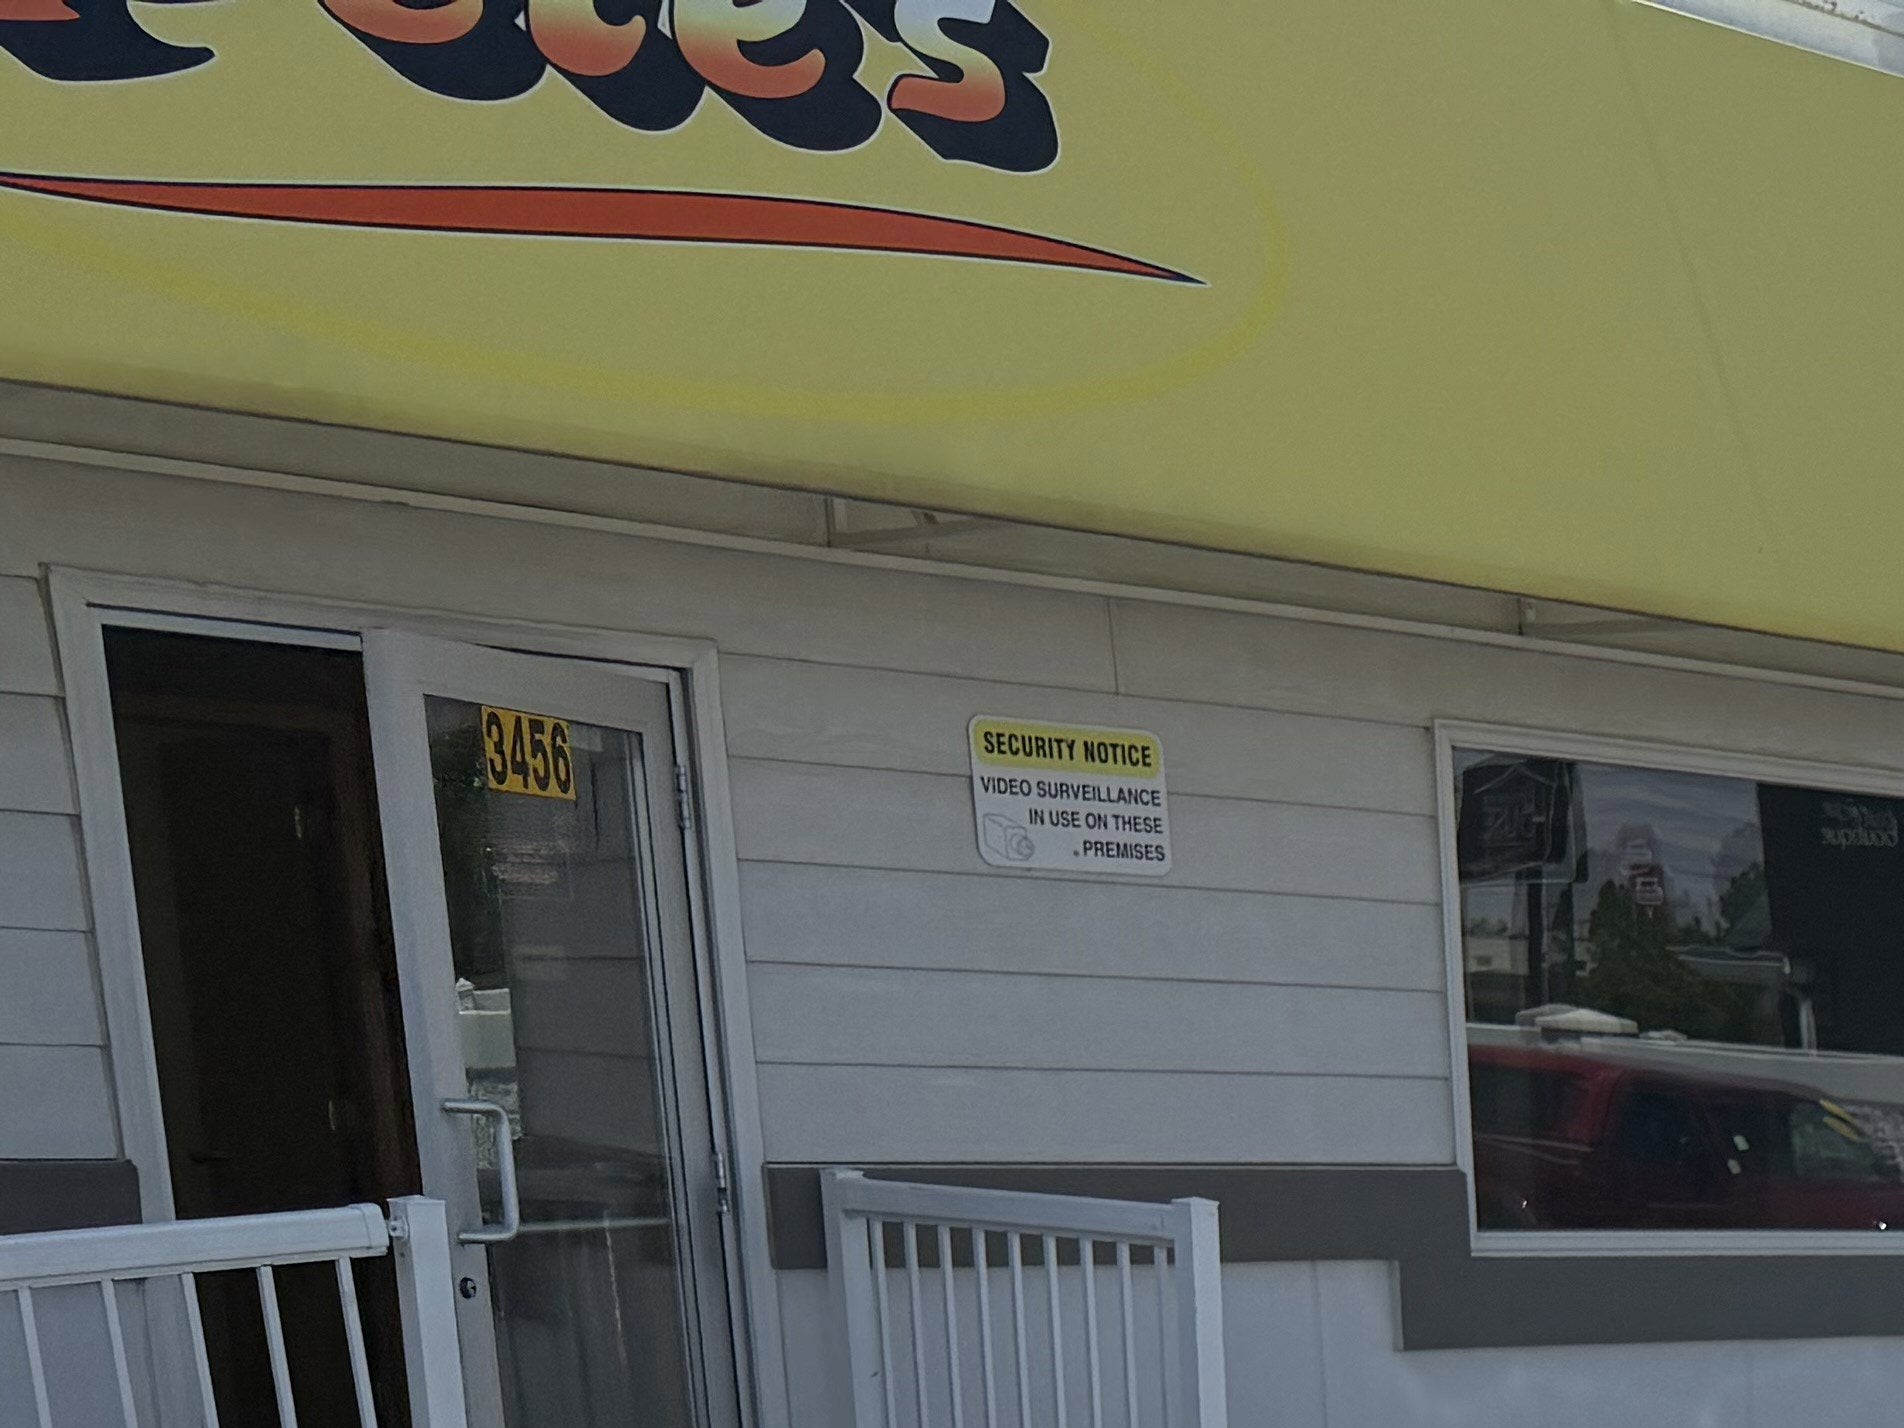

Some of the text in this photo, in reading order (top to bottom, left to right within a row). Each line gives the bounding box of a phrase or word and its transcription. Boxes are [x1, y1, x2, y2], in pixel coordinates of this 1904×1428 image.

[486, 711, 571, 795] 3456
[982, 731, 1153, 768] SECURITY NOTICE
[980, 776, 1162, 807] VIDEO SURVEILLANCE
[1028, 808, 1164, 834] IN USE ON THESE
[1083, 840, 1166, 863] PREMISES
